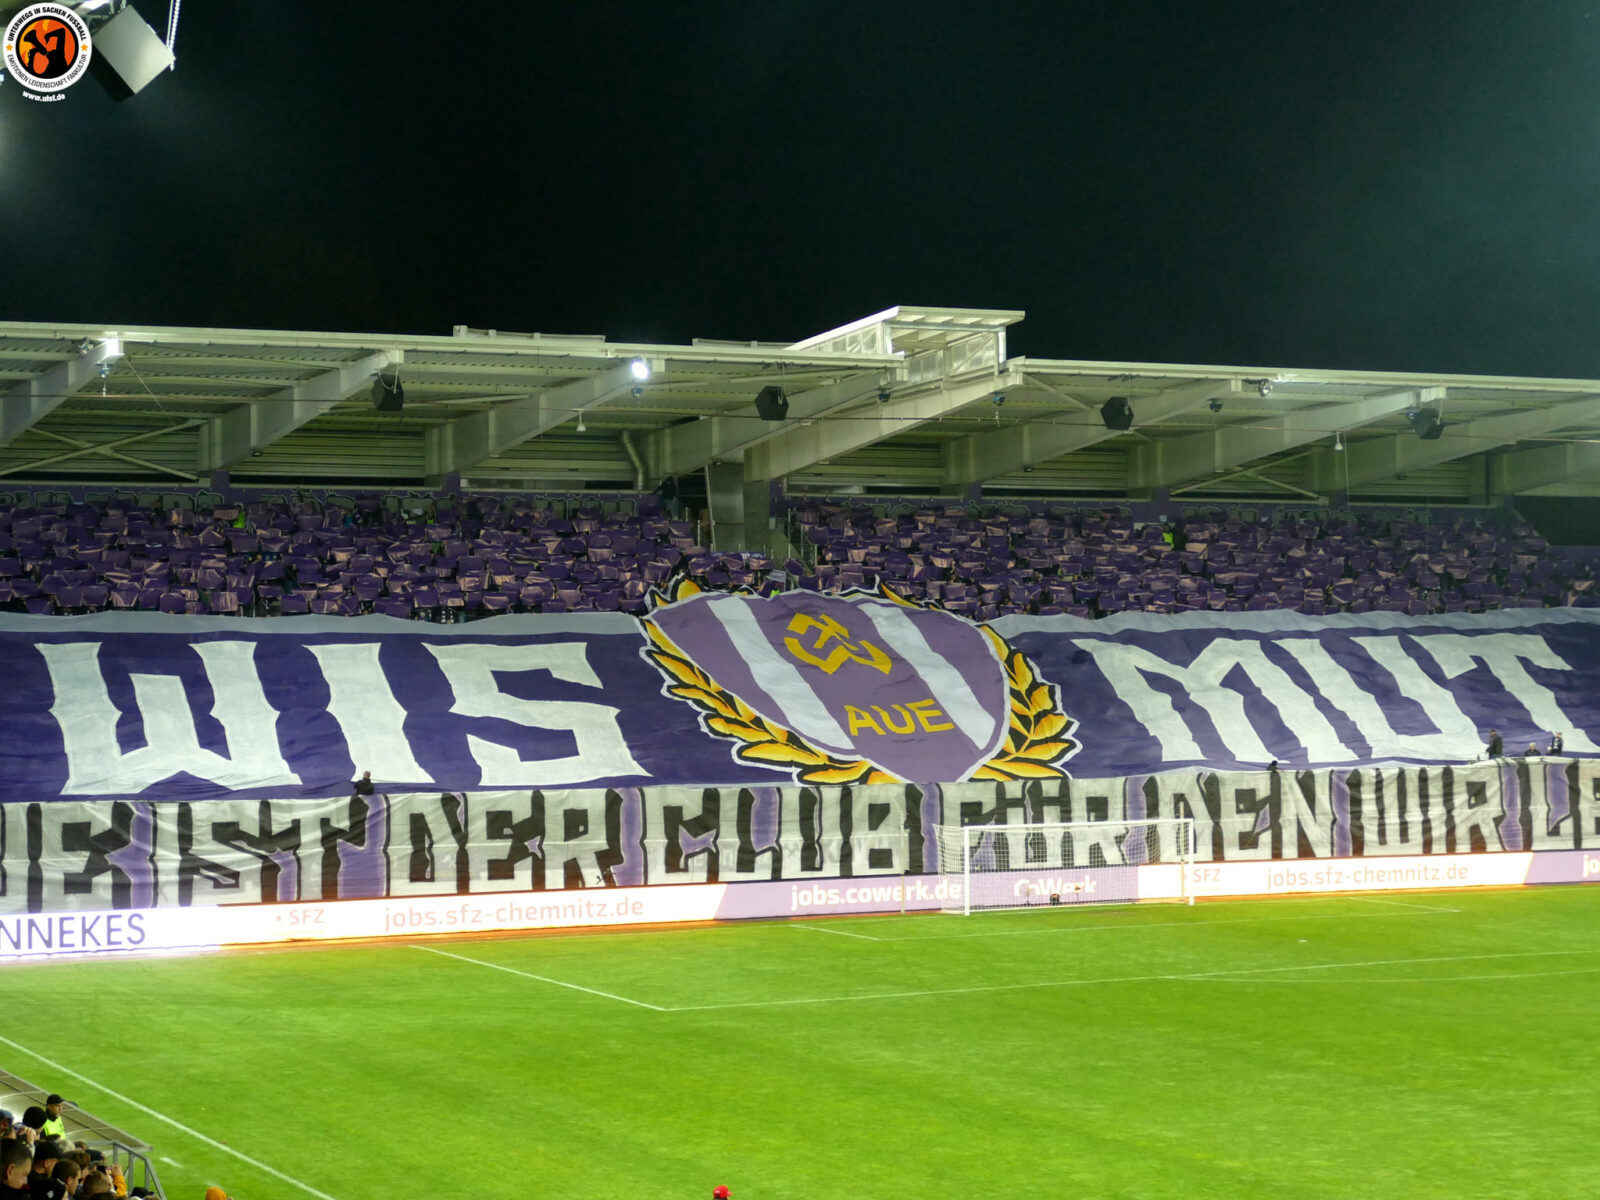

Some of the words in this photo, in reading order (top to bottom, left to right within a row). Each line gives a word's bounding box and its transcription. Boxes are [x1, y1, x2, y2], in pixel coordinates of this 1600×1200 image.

[844, 697, 955, 737] AUE
[389, 787, 611, 897] DER
[645, 784, 909, 884] CLUB
[1158, 770, 1332, 863] DEN
[1361, 762, 1505, 858] WIR
[791, 873, 962, 911] jobs.cowerk.de
[1194, 868, 1221, 883] SFZ
[1267, 862, 1468, 889] jobs.sfz-chemnitz.de
[0, 912, 146, 951] NNEKES
[289, 908, 325, 925] SFZ
[384, 896, 644, 932] jobs.sfz-chemnitz.de
